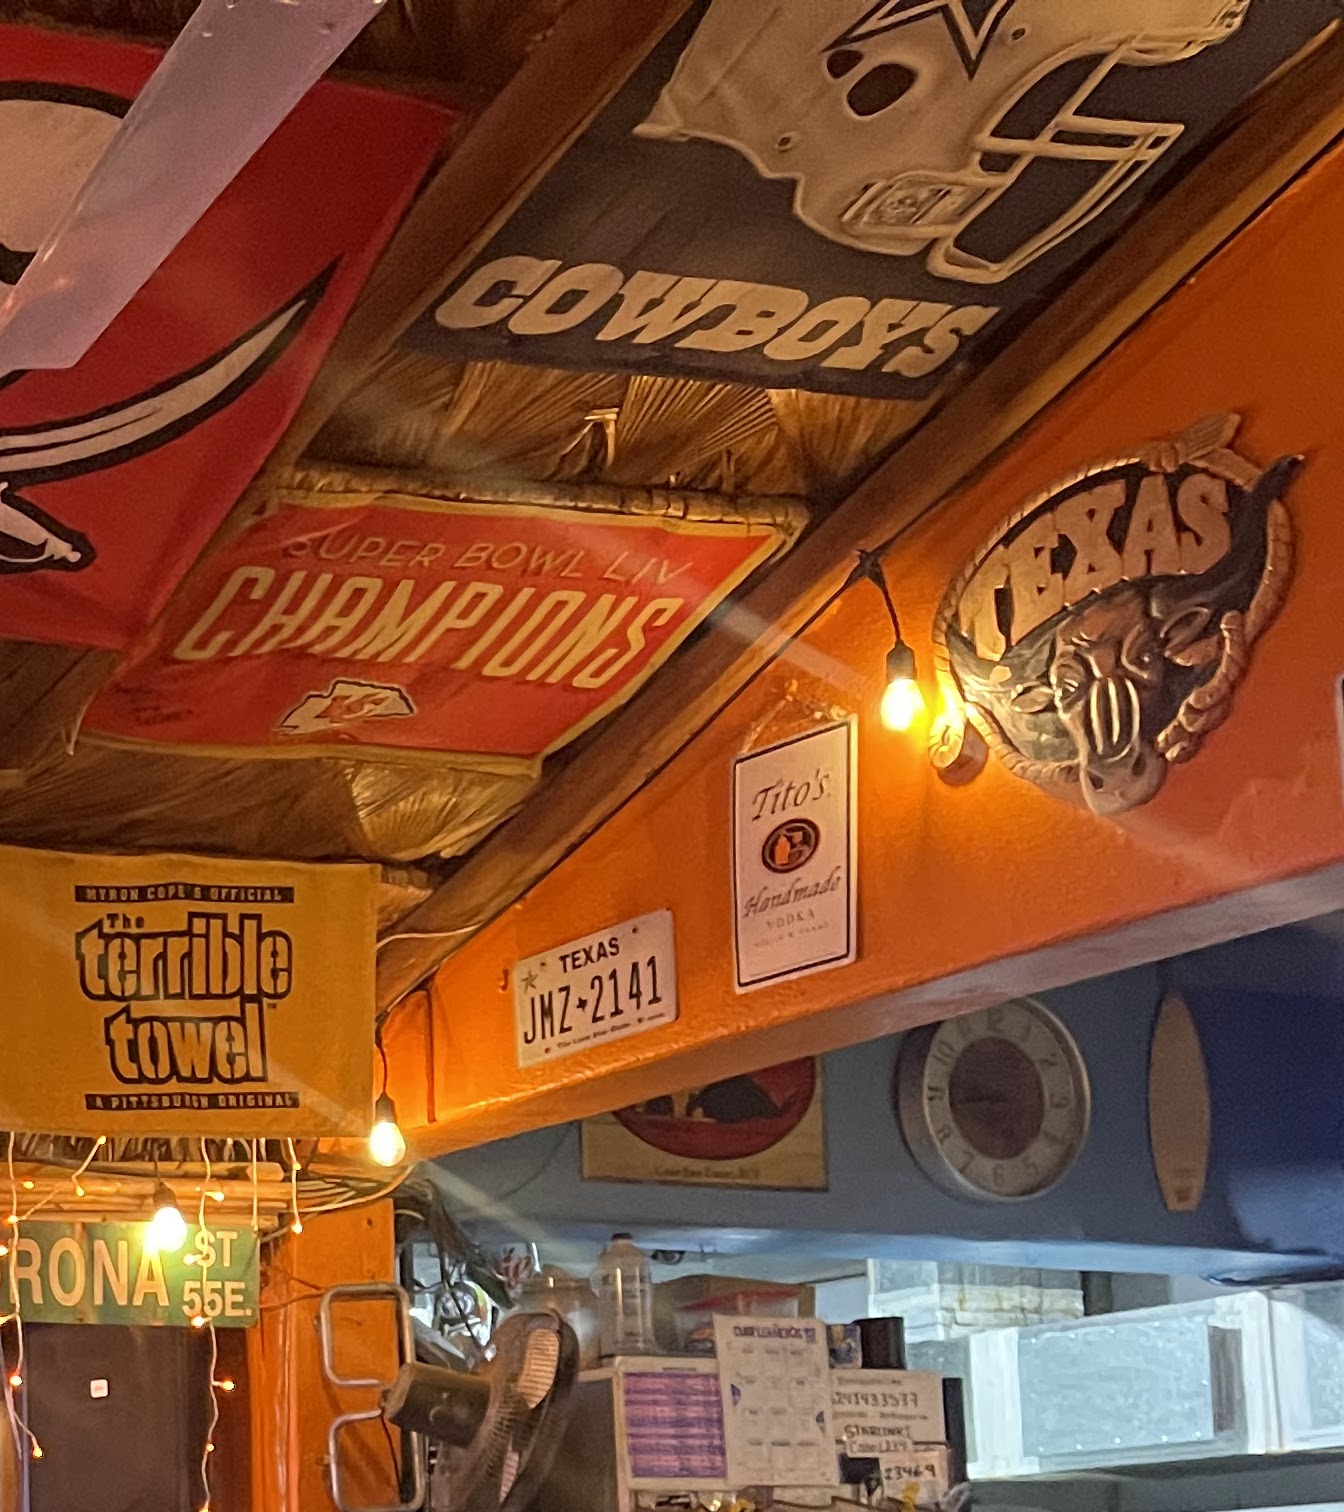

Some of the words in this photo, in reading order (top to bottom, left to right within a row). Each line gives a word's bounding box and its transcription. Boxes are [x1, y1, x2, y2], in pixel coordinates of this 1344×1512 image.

[435, 256, 1003, 379] COWBOYS
[285, 532, 446, 569] SUPER
[454, 543, 585, 580] BOWL
[596, 552, 694, 586] LIV
[958, 472, 1233, 663] TEXAS
[173, 565, 685, 689] CHAMPIONS
[752, 768, 830, 822] Tito's
[86, 886, 139, 901] MYRON
[210, 886, 282, 901] OFFICIAL
[744, 865, 842, 918] Handmade
[106, 912, 145, 929] The
[75, 911, 294, 1000] terrible
[558, 936, 621, 974] TEXAS
[104, 997, 268, 1085] towel
[217, 1092, 294, 1108] ORIGINAL
[193, 1230, 238, 1268] ST
[182, 1280, 253, 1318] 55E.
